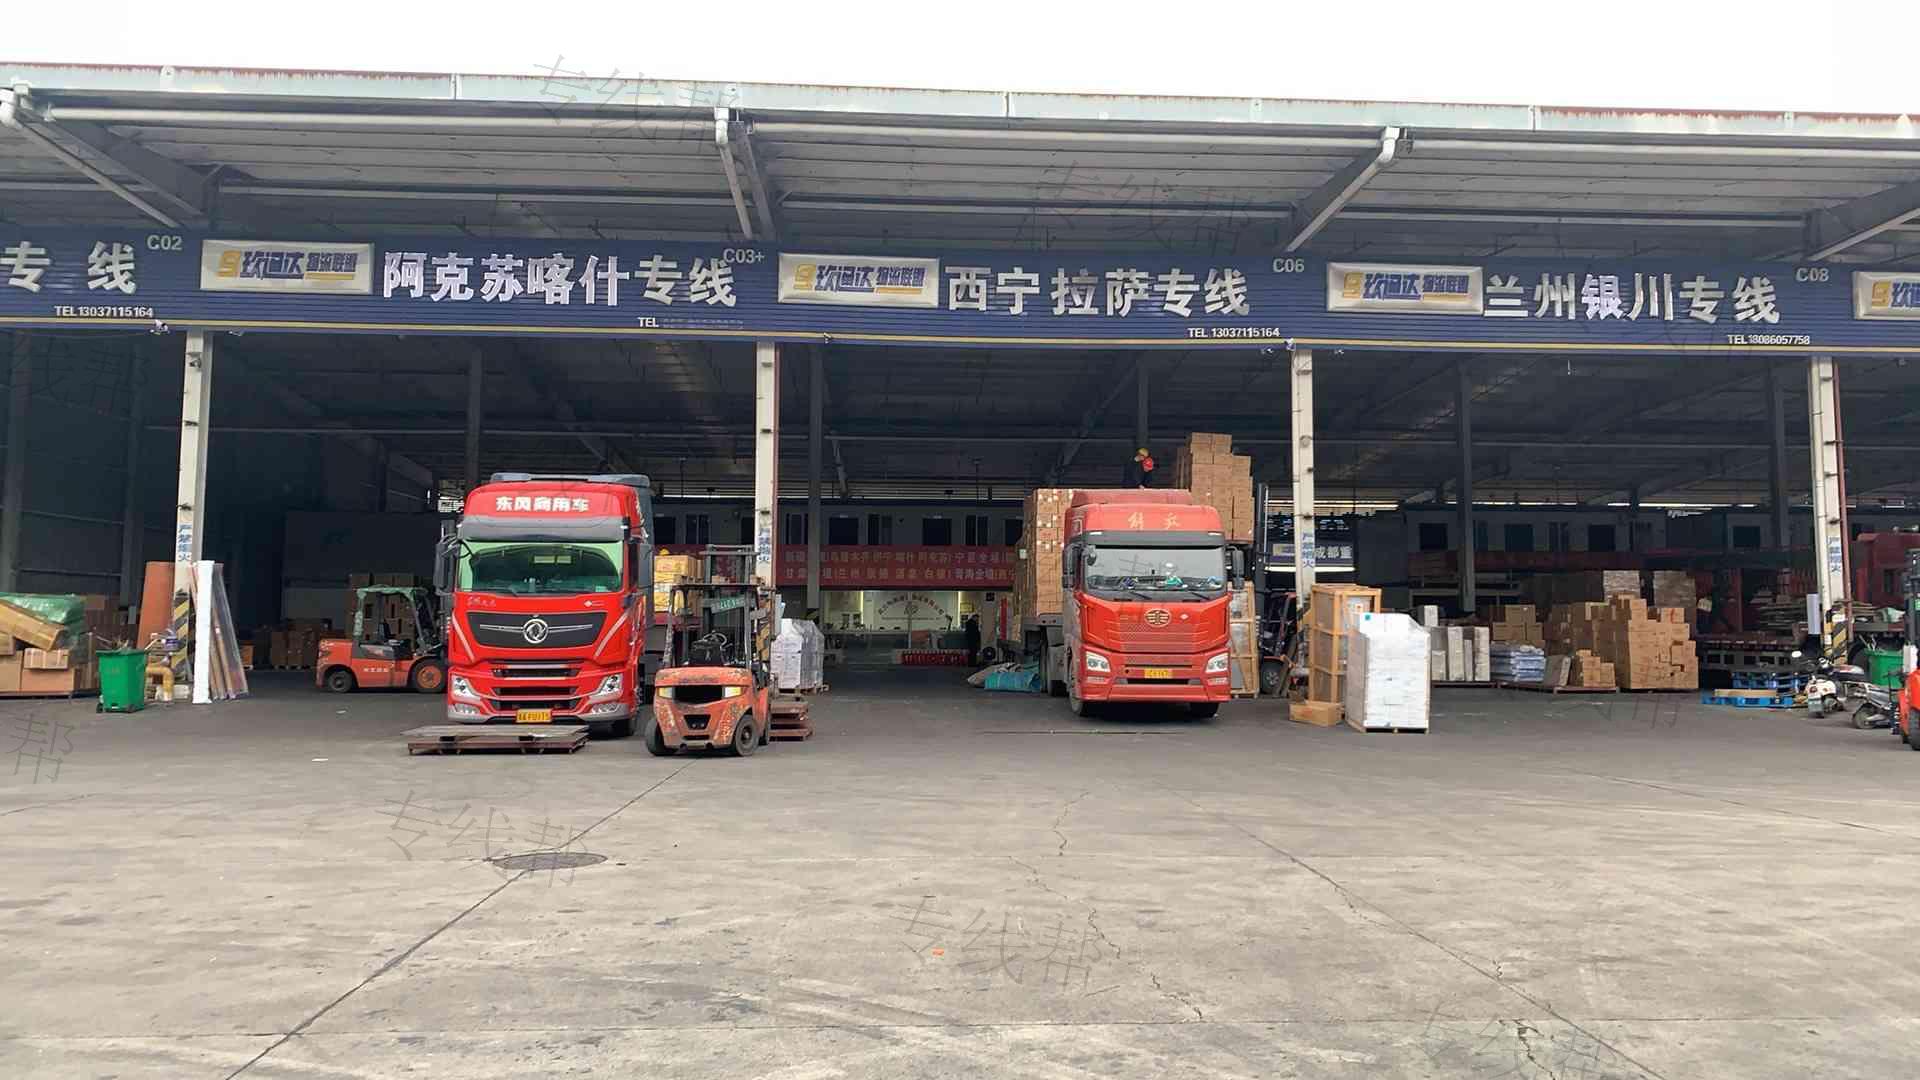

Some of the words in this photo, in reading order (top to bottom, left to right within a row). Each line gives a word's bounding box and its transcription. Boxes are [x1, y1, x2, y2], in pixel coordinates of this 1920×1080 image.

[147, 235, 182, 250] C02
[723, 248, 764, 264] C03+
[1272, 258, 1305, 272] C06
[383, 251, 737, 307] 阿克苏喀什专线
[1796, 267, 1829, 282] C08
[945, 266, 1250, 317] 西宁拉萨专线
[1484, 273, 1780, 323] 兰州银川专线
[637, 317, 659, 328] TEL
[1187, 327, 1208, 338] TEL
[1211, 327, 1281, 337] 13037115164
[496, 496, 590, 512] 东风商用车
